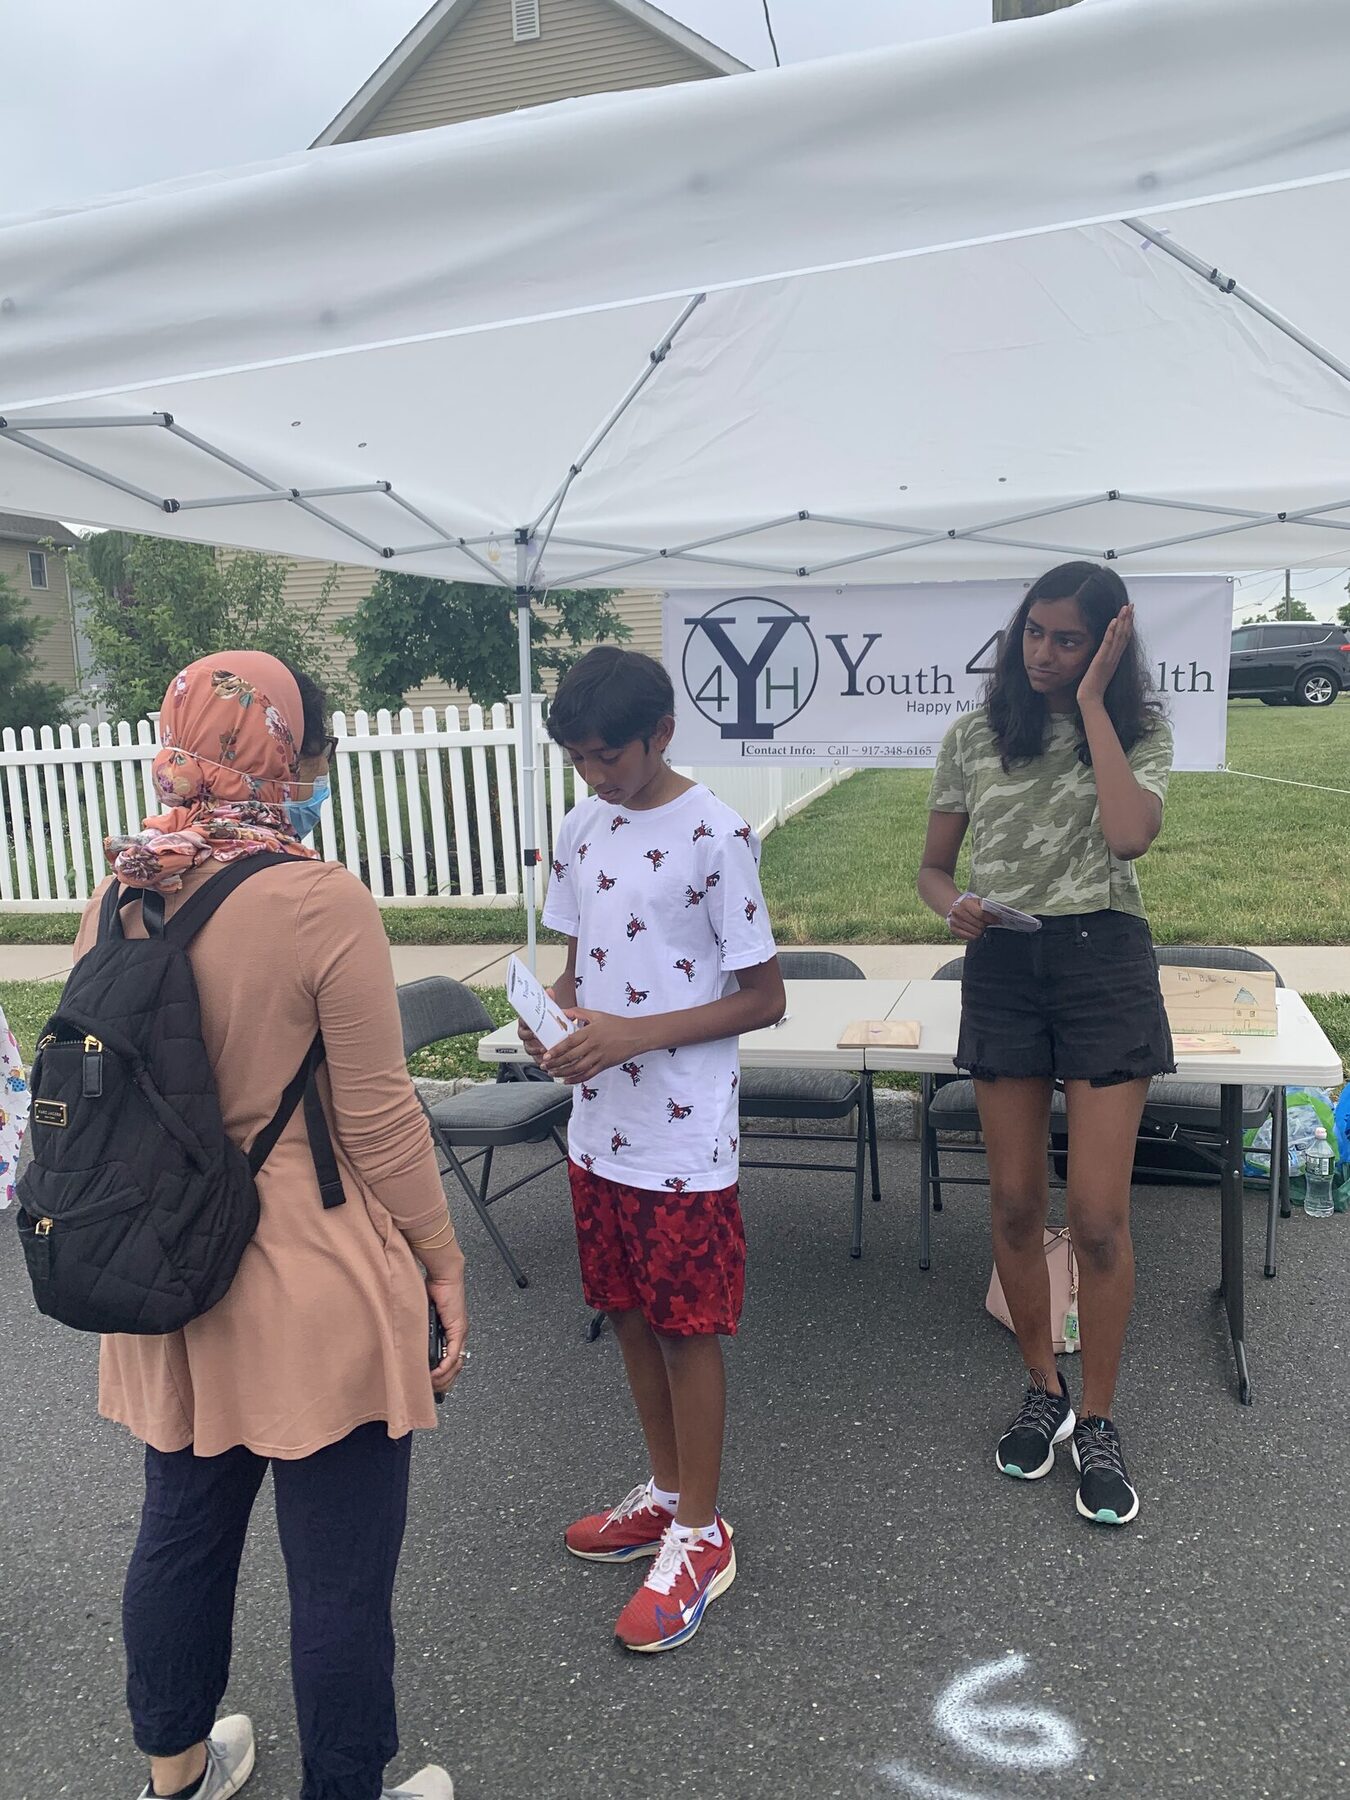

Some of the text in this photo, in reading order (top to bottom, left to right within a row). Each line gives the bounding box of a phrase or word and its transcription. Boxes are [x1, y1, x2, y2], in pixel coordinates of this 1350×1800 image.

[825, 634, 955, 696] Youth
[906, 700, 951, 715] Happy
[746, 744, 787, 756] Contact
[789, 744, 816, 756] Info:
[827, 744, 849, 756] Call
[861, 745, 932, 756] 917-348-6165
